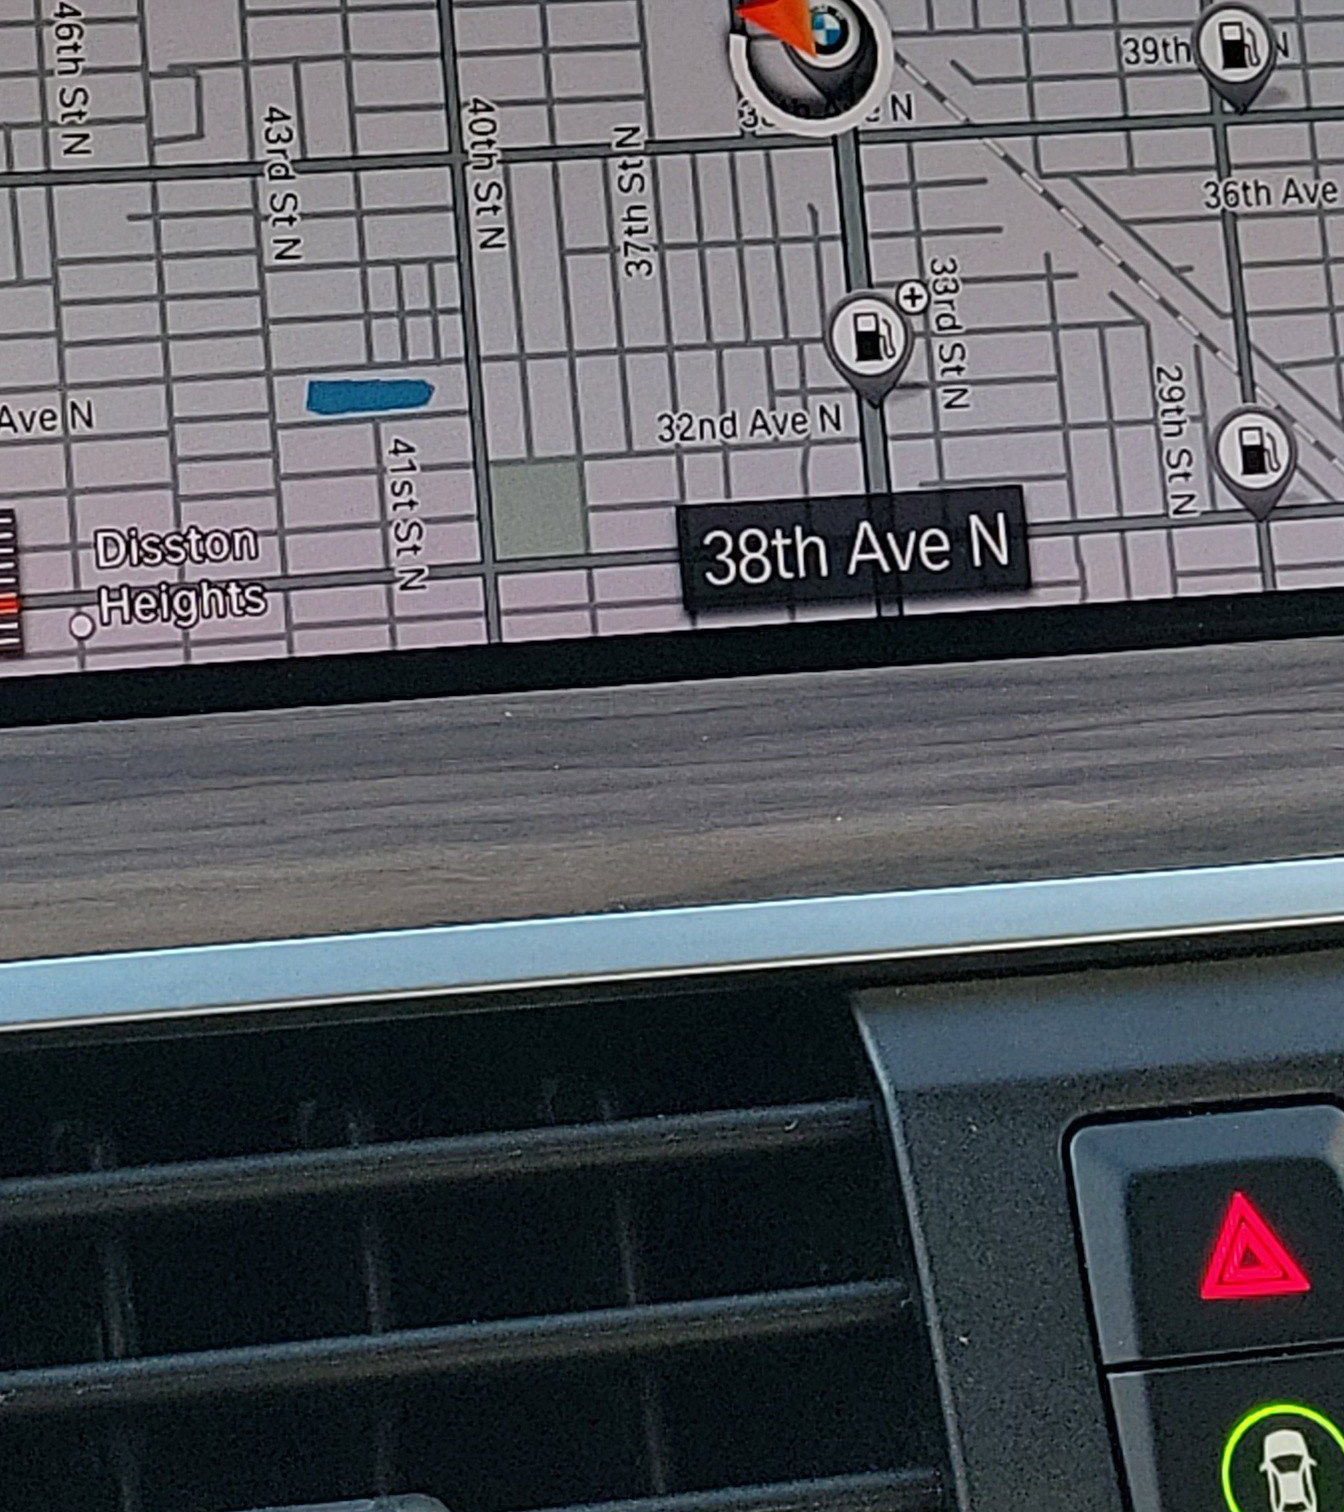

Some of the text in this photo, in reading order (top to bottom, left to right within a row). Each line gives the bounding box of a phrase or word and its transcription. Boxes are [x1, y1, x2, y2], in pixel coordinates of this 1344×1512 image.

[54, 1, 90, 156] 46th St N
[1123, 36, 1191, 65] 39th
[891, 94, 912, 121] N
[264, 106, 301, 261] 43rd St N
[467, 97, 506, 250] 40th St N
[613, 126, 652, 278] 37th St N
[1203, 180, 1271, 210] 36th
[1281, 180, 1340, 207] Ave
[930, 258, 968, 409] 33rd St N
[67, 402, 93, 430] N
[657, 404, 842, 443] 32nd Ave N
[1156, 365, 1196, 515] 29th St N
[94, 528, 259, 570] Disston
[389, 438, 426, 590] 41st St N
[703, 514, 1010, 586] 38th Ave N
[98, 583, 267, 628] Heights
